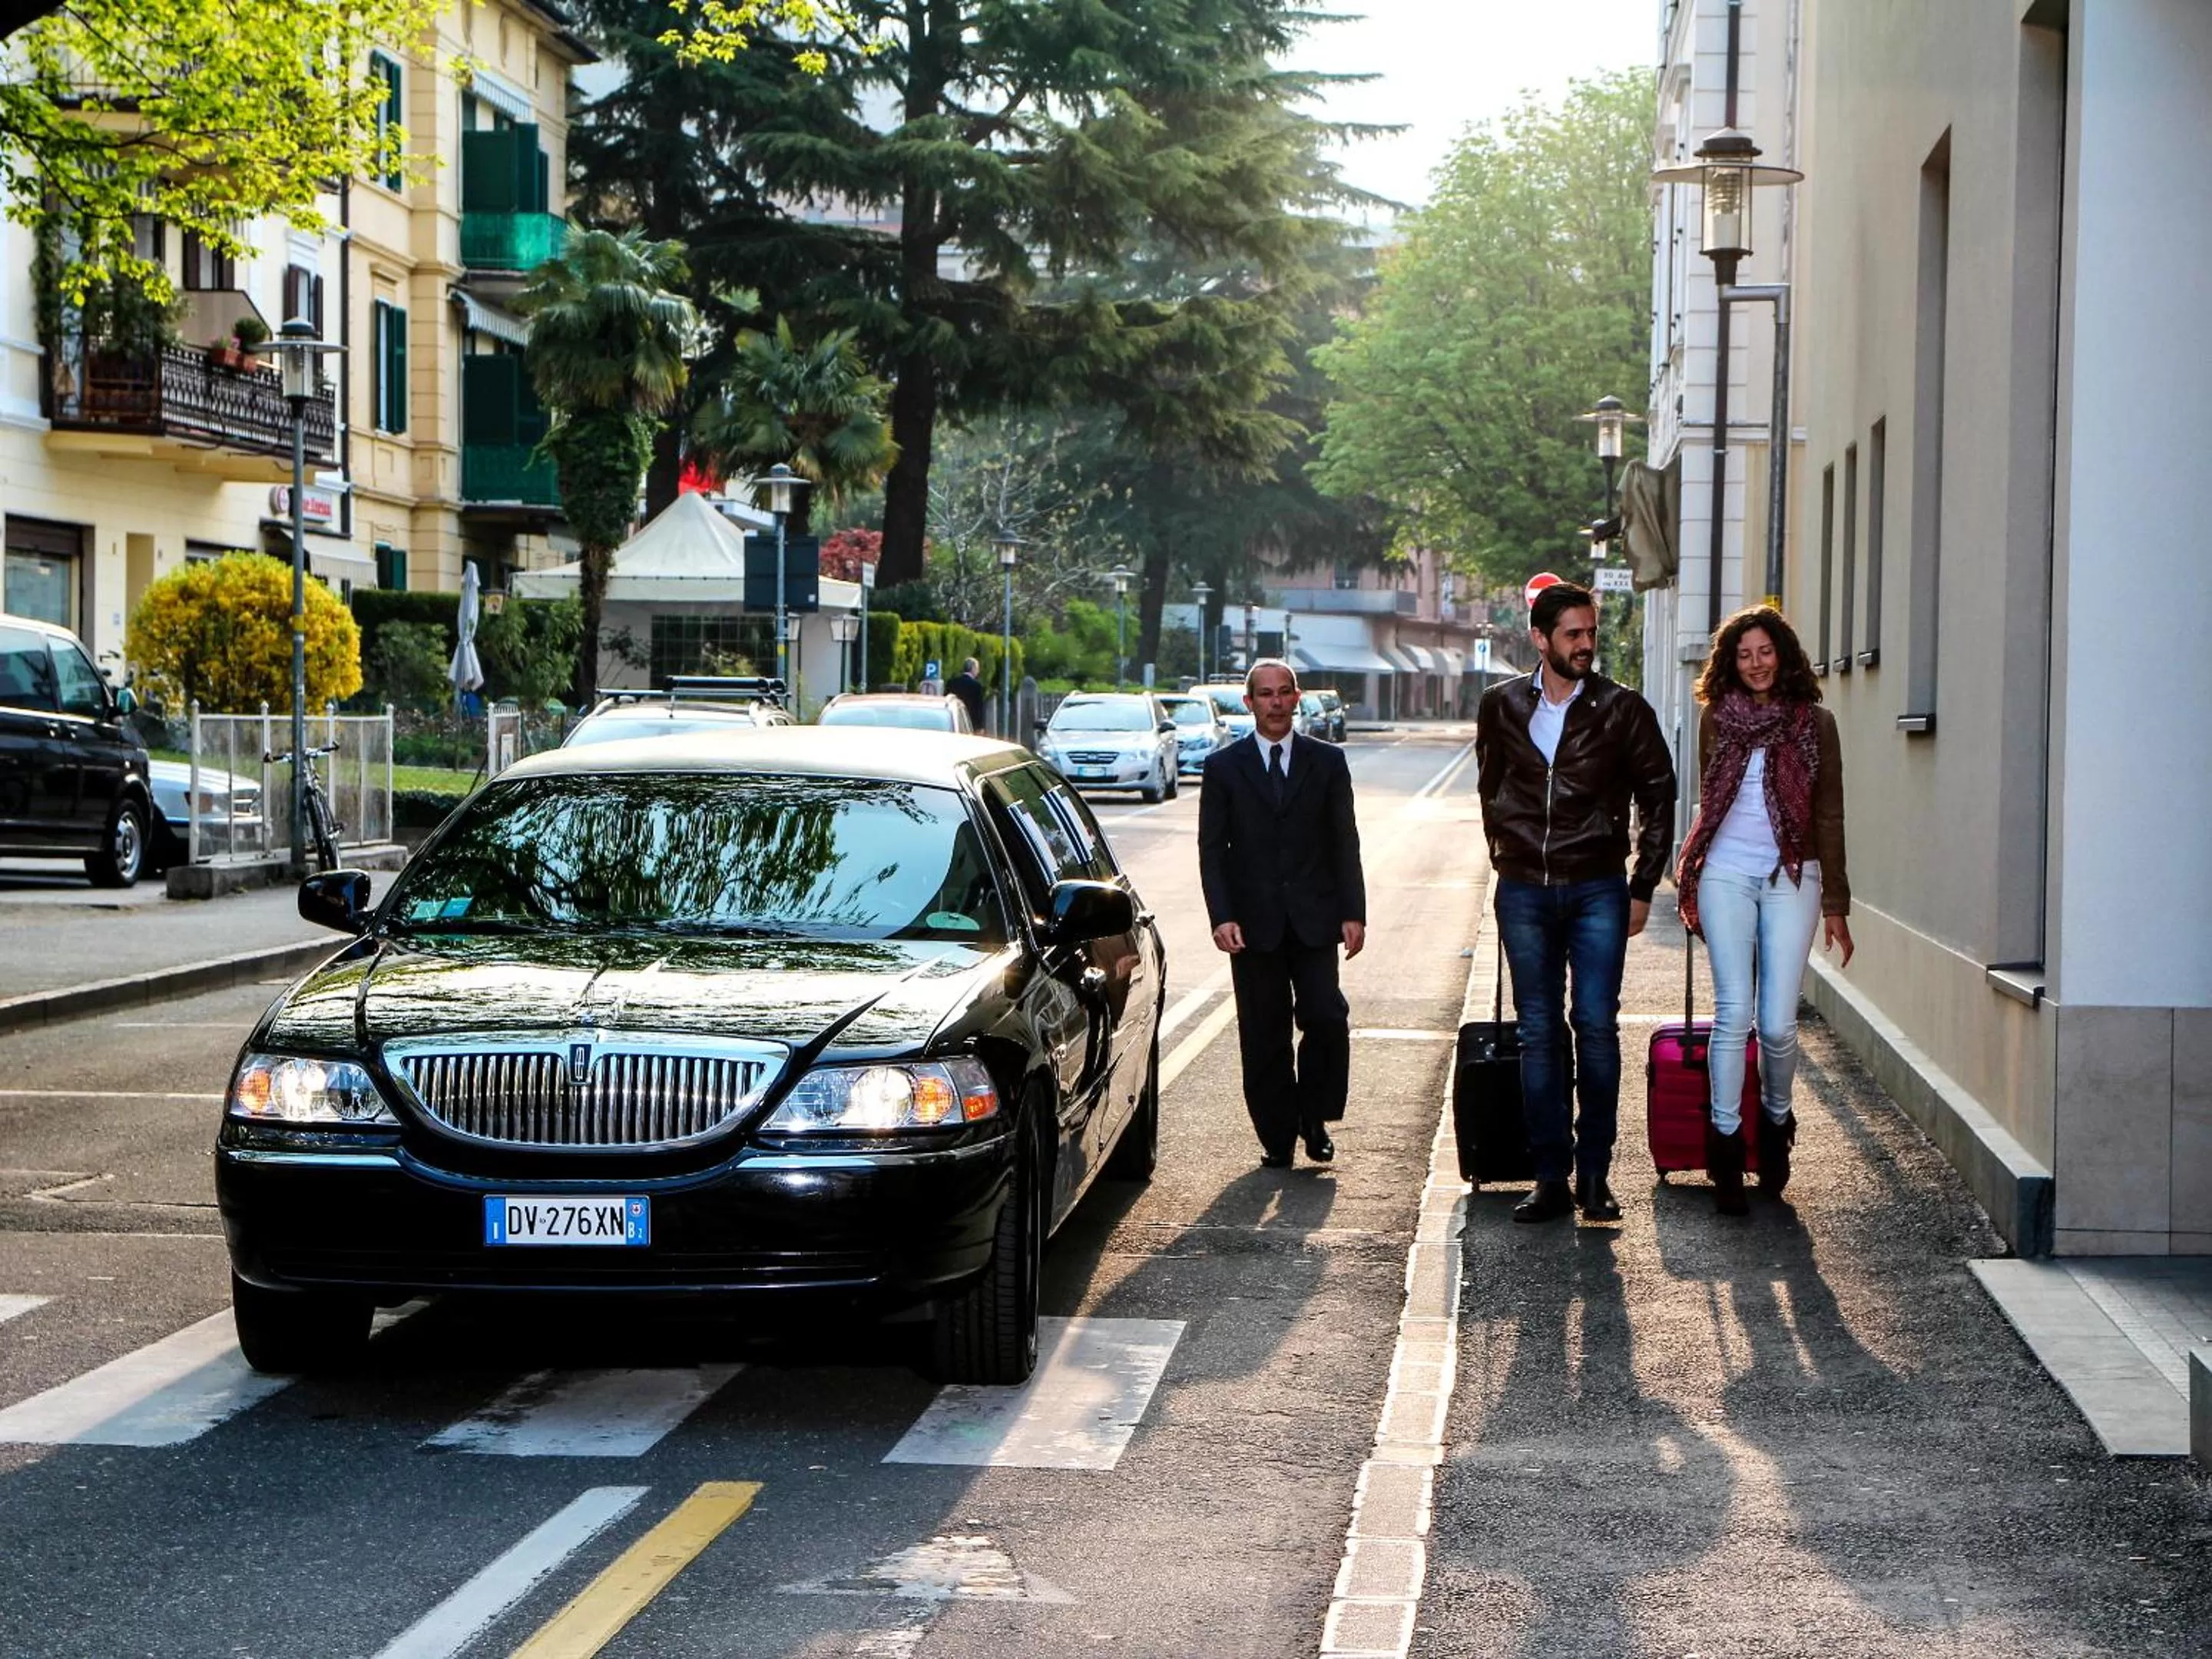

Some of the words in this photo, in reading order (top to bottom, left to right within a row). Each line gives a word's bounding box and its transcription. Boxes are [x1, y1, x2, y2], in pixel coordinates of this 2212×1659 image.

[926, 663, 937, 677] P
[508, 1206, 538, 1235] DV
[546, 1207, 624, 1236] 276XN
